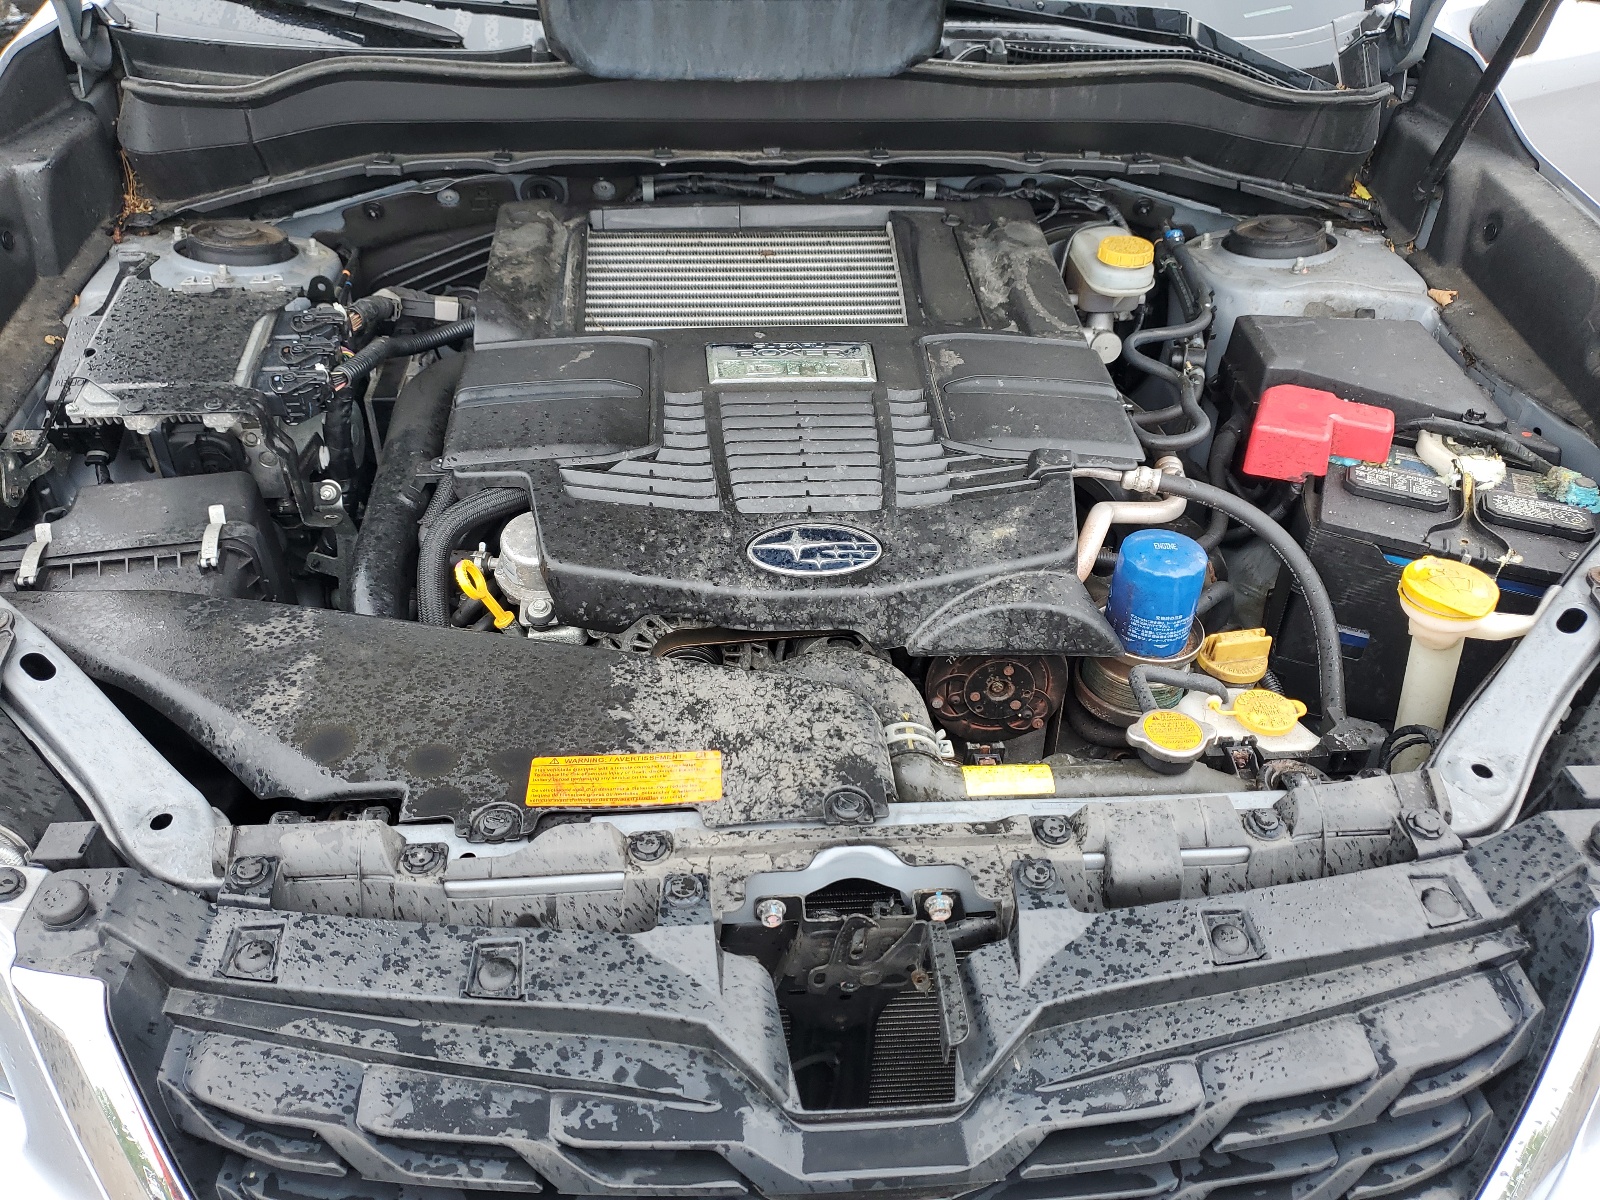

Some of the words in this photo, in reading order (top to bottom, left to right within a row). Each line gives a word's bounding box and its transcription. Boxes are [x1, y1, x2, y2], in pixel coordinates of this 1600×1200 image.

[737, 348, 844, 357] BOXER
[1153, 542, 1179, 551] ENGINE
[614, 754, 682, 762] AVERTISSEMENT
